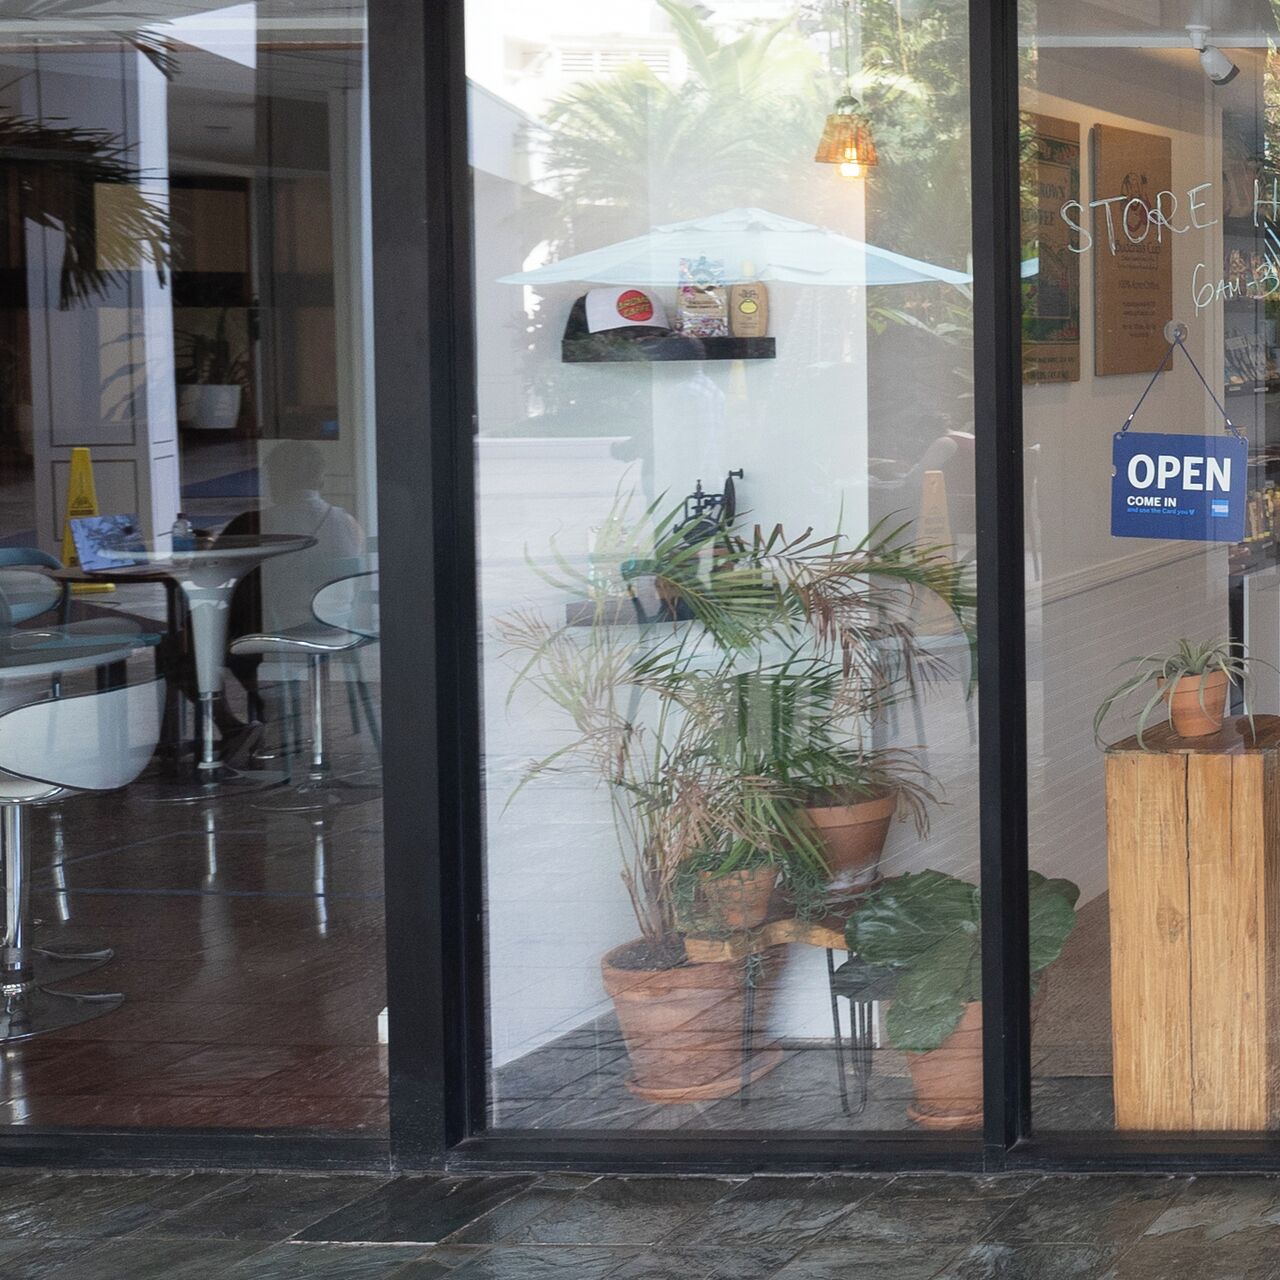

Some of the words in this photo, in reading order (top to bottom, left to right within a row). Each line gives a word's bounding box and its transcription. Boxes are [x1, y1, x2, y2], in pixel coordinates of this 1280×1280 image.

[1060, 183, 1218, 256] STORE
[1127, 453, 1232, 492] OPEN
[1126, 495, 1162, 507] COME
[1163, 496, 1177, 508] IN
